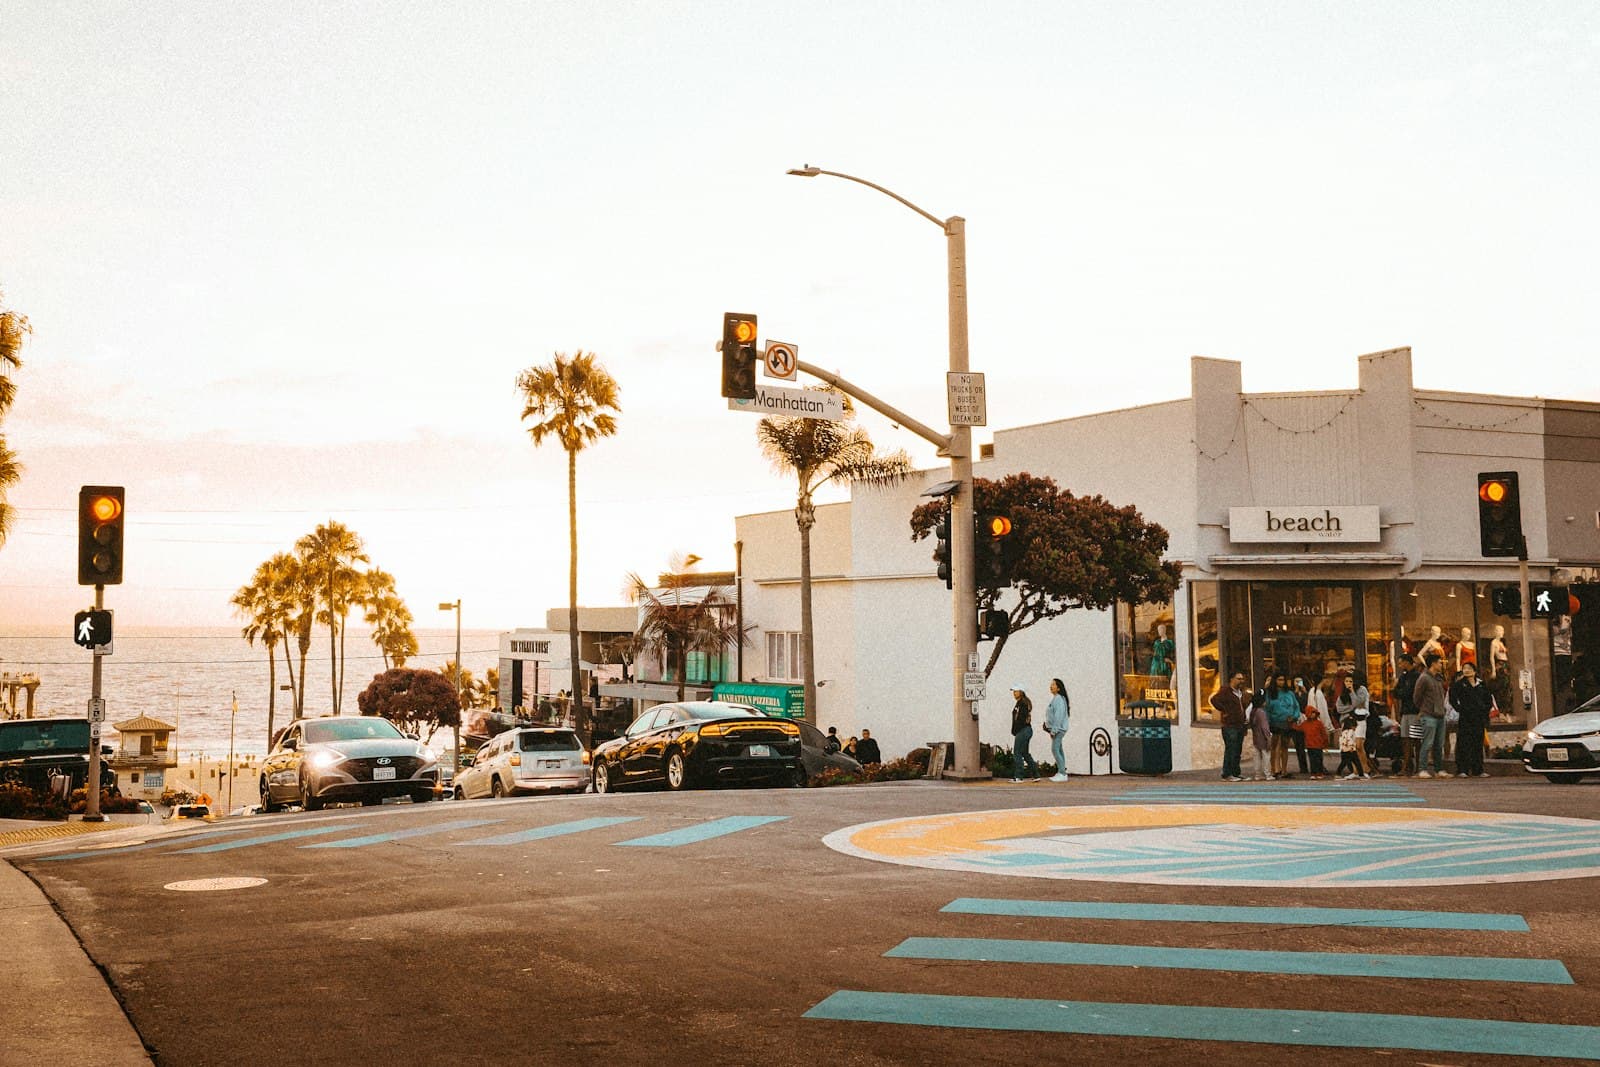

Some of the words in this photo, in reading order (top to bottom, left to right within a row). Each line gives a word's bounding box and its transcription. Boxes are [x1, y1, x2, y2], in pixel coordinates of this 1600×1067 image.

[961, 376, 971, 384] NO
[951, 385, 973, 394] TRUCKS
[975, 386, 983, 394] OR
[754, 389, 824, 413] Manhattan
[957, 396, 977, 404] BUSES
[955, 405, 970, 413] WEST
[952, 415, 971, 423] OCEAN
[1266, 510, 1342, 531] beach
[1283, 601, 1330, 615] beach
[718, 693, 752, 704] MANHATTAN
[752, 696, 781, 707] PIZZERIA
